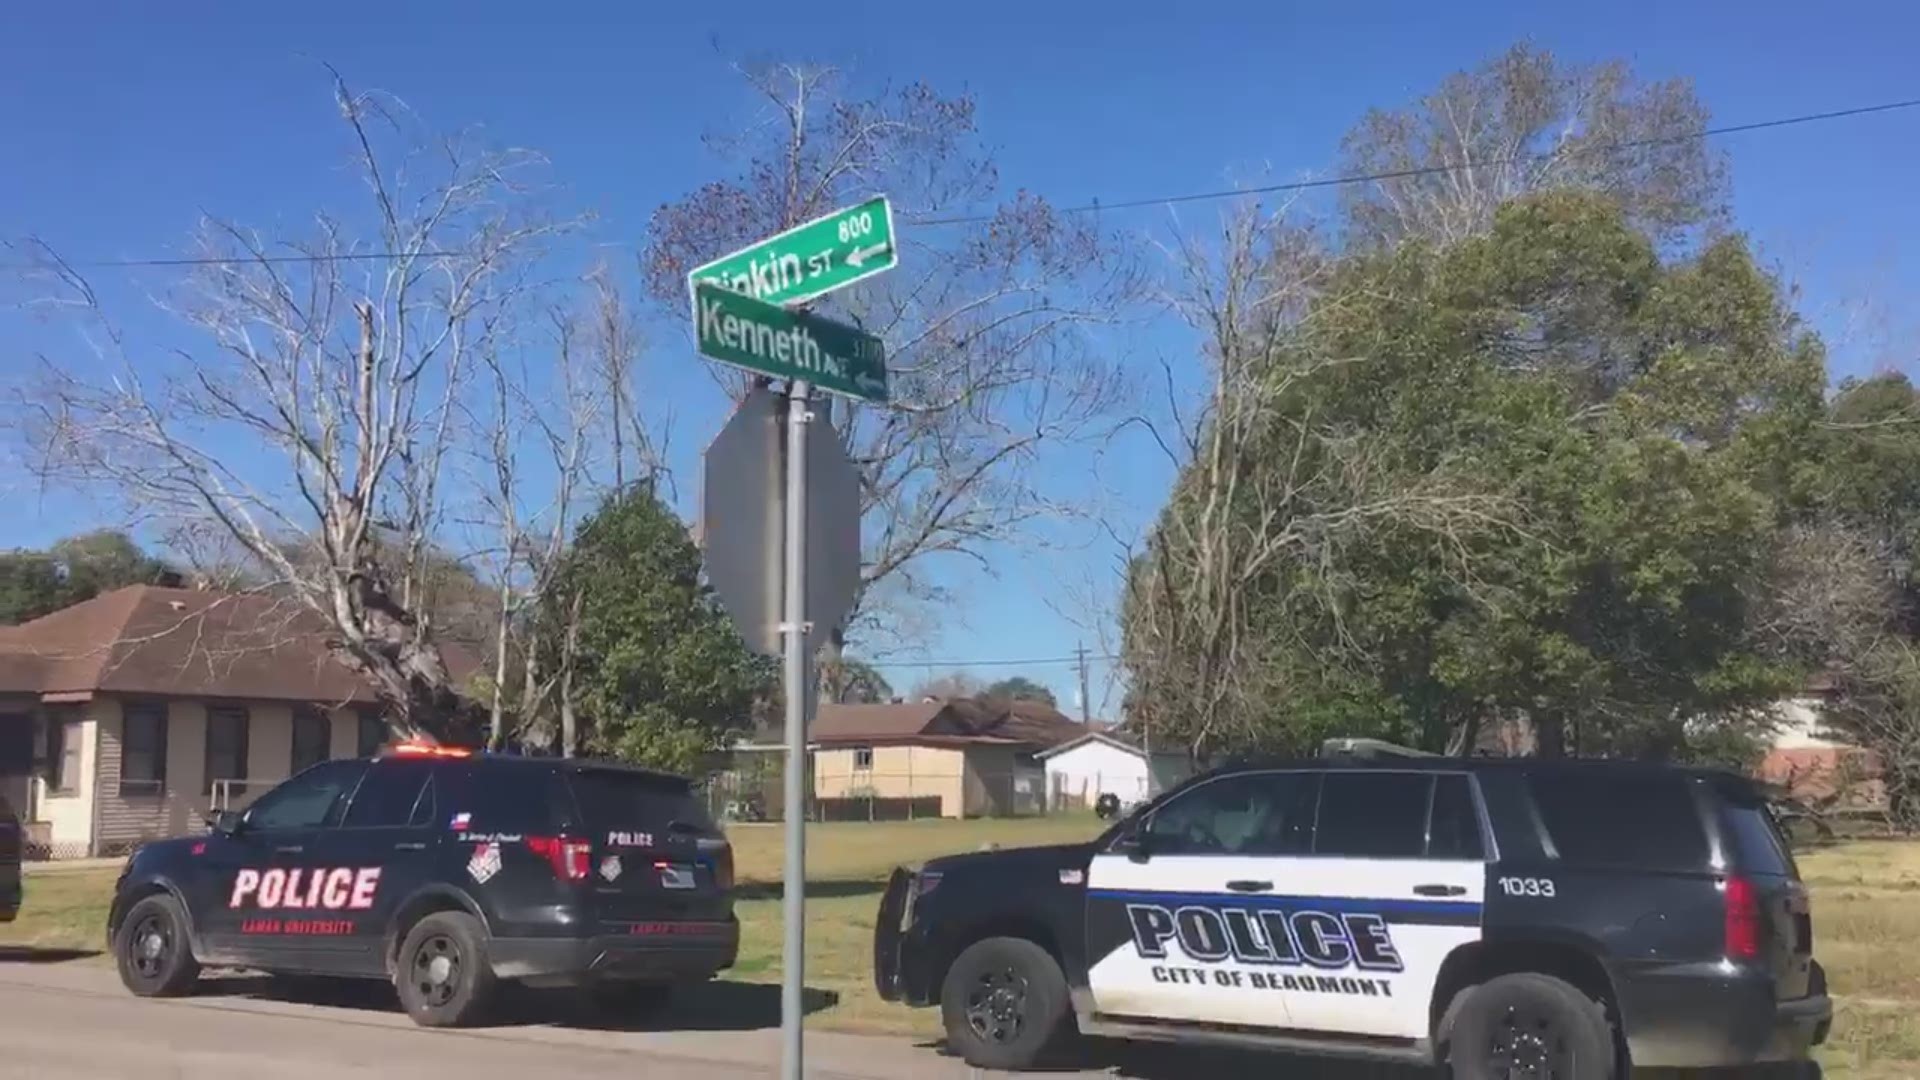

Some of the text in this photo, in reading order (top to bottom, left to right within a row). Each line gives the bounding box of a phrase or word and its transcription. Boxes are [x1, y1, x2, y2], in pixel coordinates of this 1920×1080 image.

[838, 213, 872, 243] 800
[698, 249, 834, 300] kin ST
[701, 297, 820, 371] Kenneth
[607, 831, 653, 847] POLICE
[229, 867, 382, 908] POLICE
[1498, 877, 1556, 897] 1033
[284, 921, 354, 935] UNIVERSITY
[1126, 903, 1405, 972] POLICE
[1152, 967, 1393, 997] CITY OF BEAUMONT
